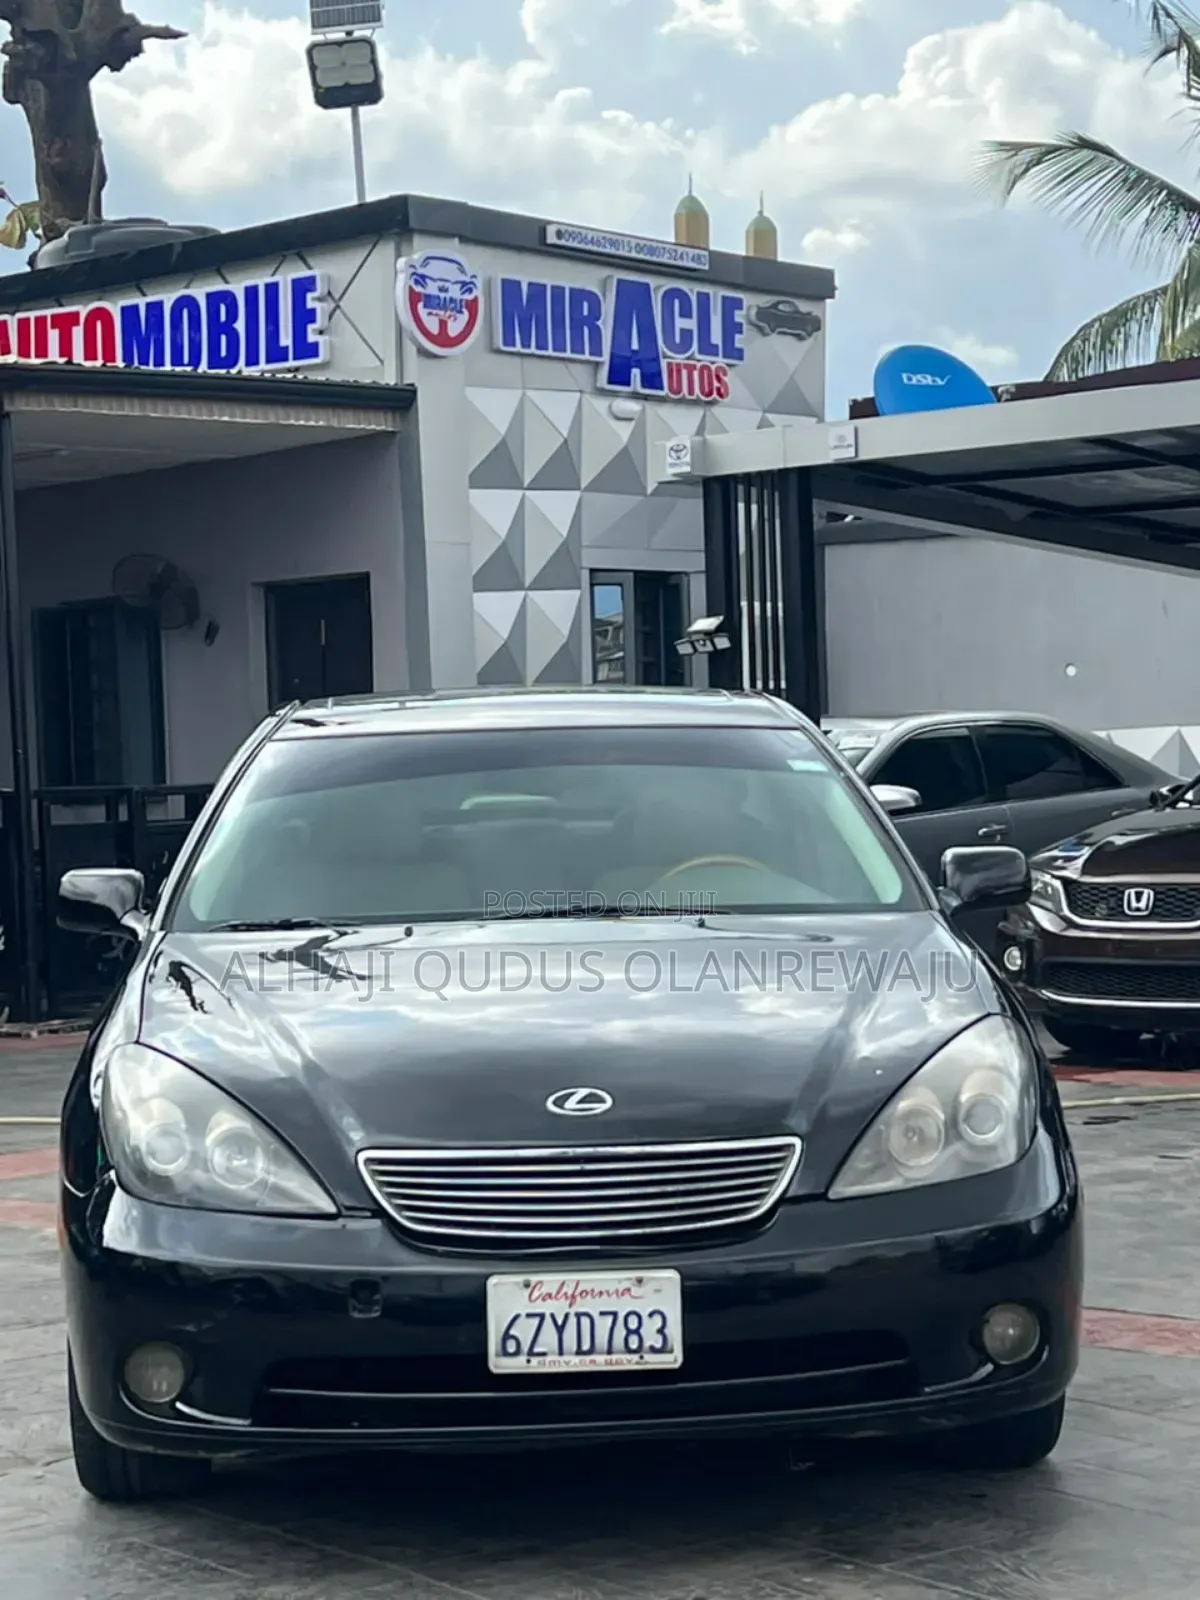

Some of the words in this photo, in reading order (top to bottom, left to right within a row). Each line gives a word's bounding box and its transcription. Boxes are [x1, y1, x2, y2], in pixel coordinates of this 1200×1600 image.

[501, 277, 745, 394] MIRACLE
[528, 1280, 645, 1308] California
[501, 1309, 669, 1357] 6ZYD783
